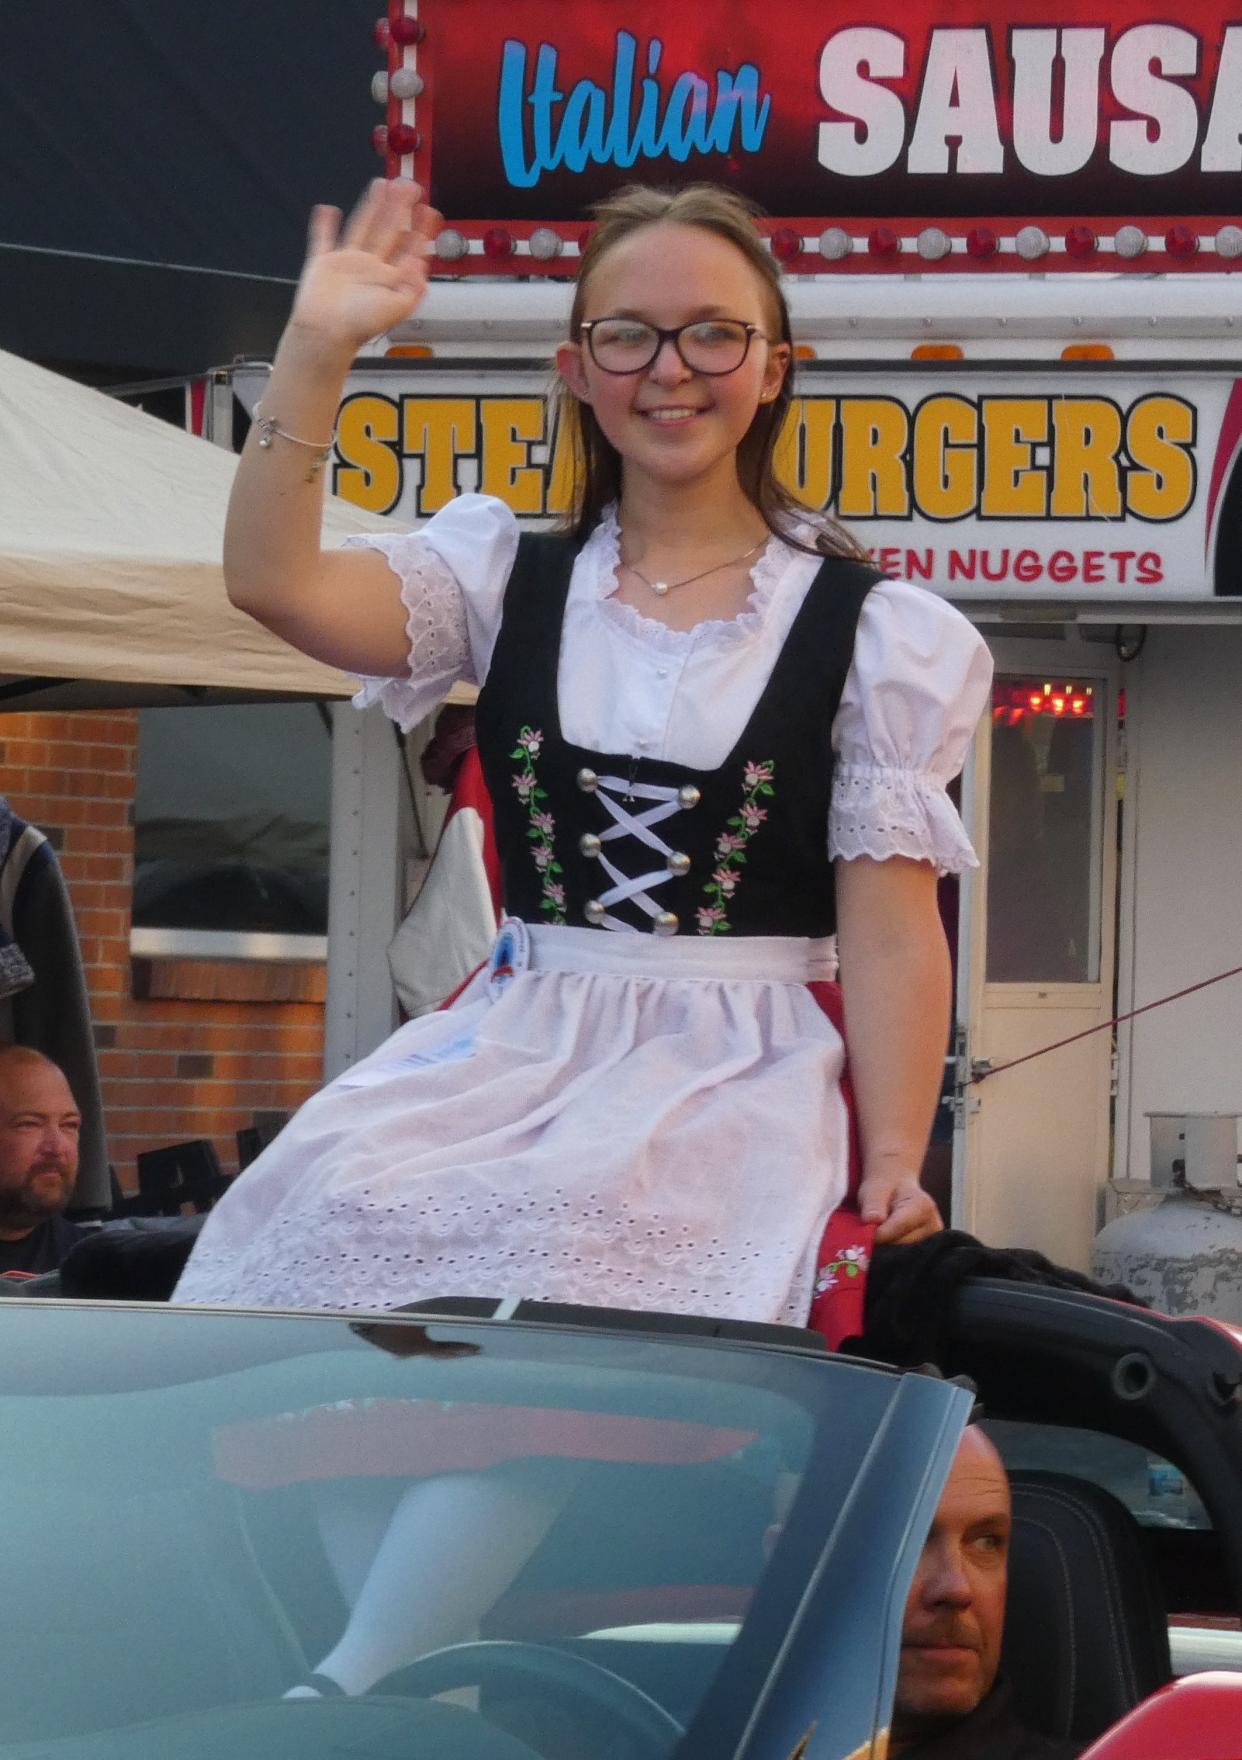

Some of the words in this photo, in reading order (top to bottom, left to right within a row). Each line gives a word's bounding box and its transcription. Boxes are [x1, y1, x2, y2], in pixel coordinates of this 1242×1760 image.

[499, 30, 771, 187] Italian
[771, 392, 1197, 522] URGERS
[947, 548, 1164, 584] NUGGETS
